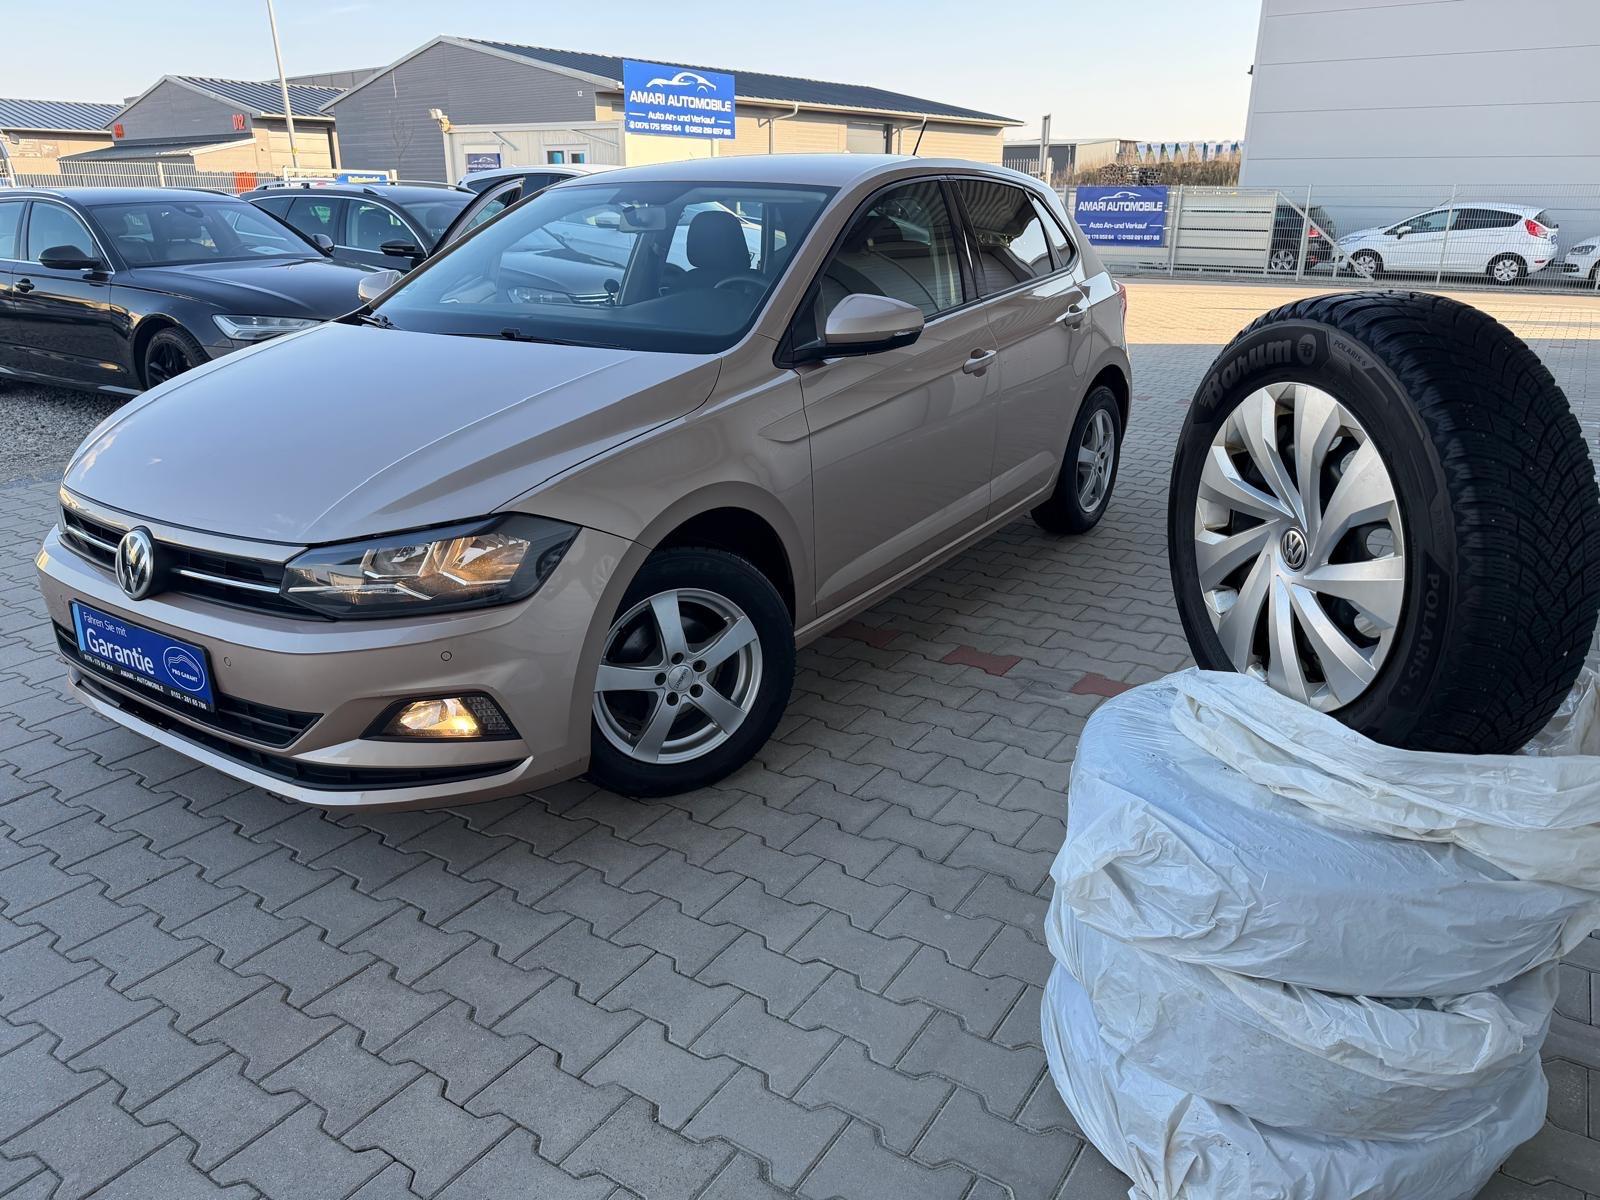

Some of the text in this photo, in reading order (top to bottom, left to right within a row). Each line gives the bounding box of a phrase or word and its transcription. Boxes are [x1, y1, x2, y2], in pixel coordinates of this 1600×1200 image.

[629, 90, 731, 112] AMARI AUTOMOBILE
[648, 111, 664, 120] Auto
[677, 114, 690, 122] und
[690, 115, 715, 124] Verkauf
[1078, 201, 1163, 212] AMARI AUTOMOBILE
[1333, 339, 1361, 363] POLARIS
[1199, 339, 1292, 409] Barum
[83, 611, 127, 638] Fahren Sie mit
[1408, 572, 1441, 682] POLARIS
[86, 628, 155, 675] Garantie
[171, 668, 198, 682] PRO GARANT
